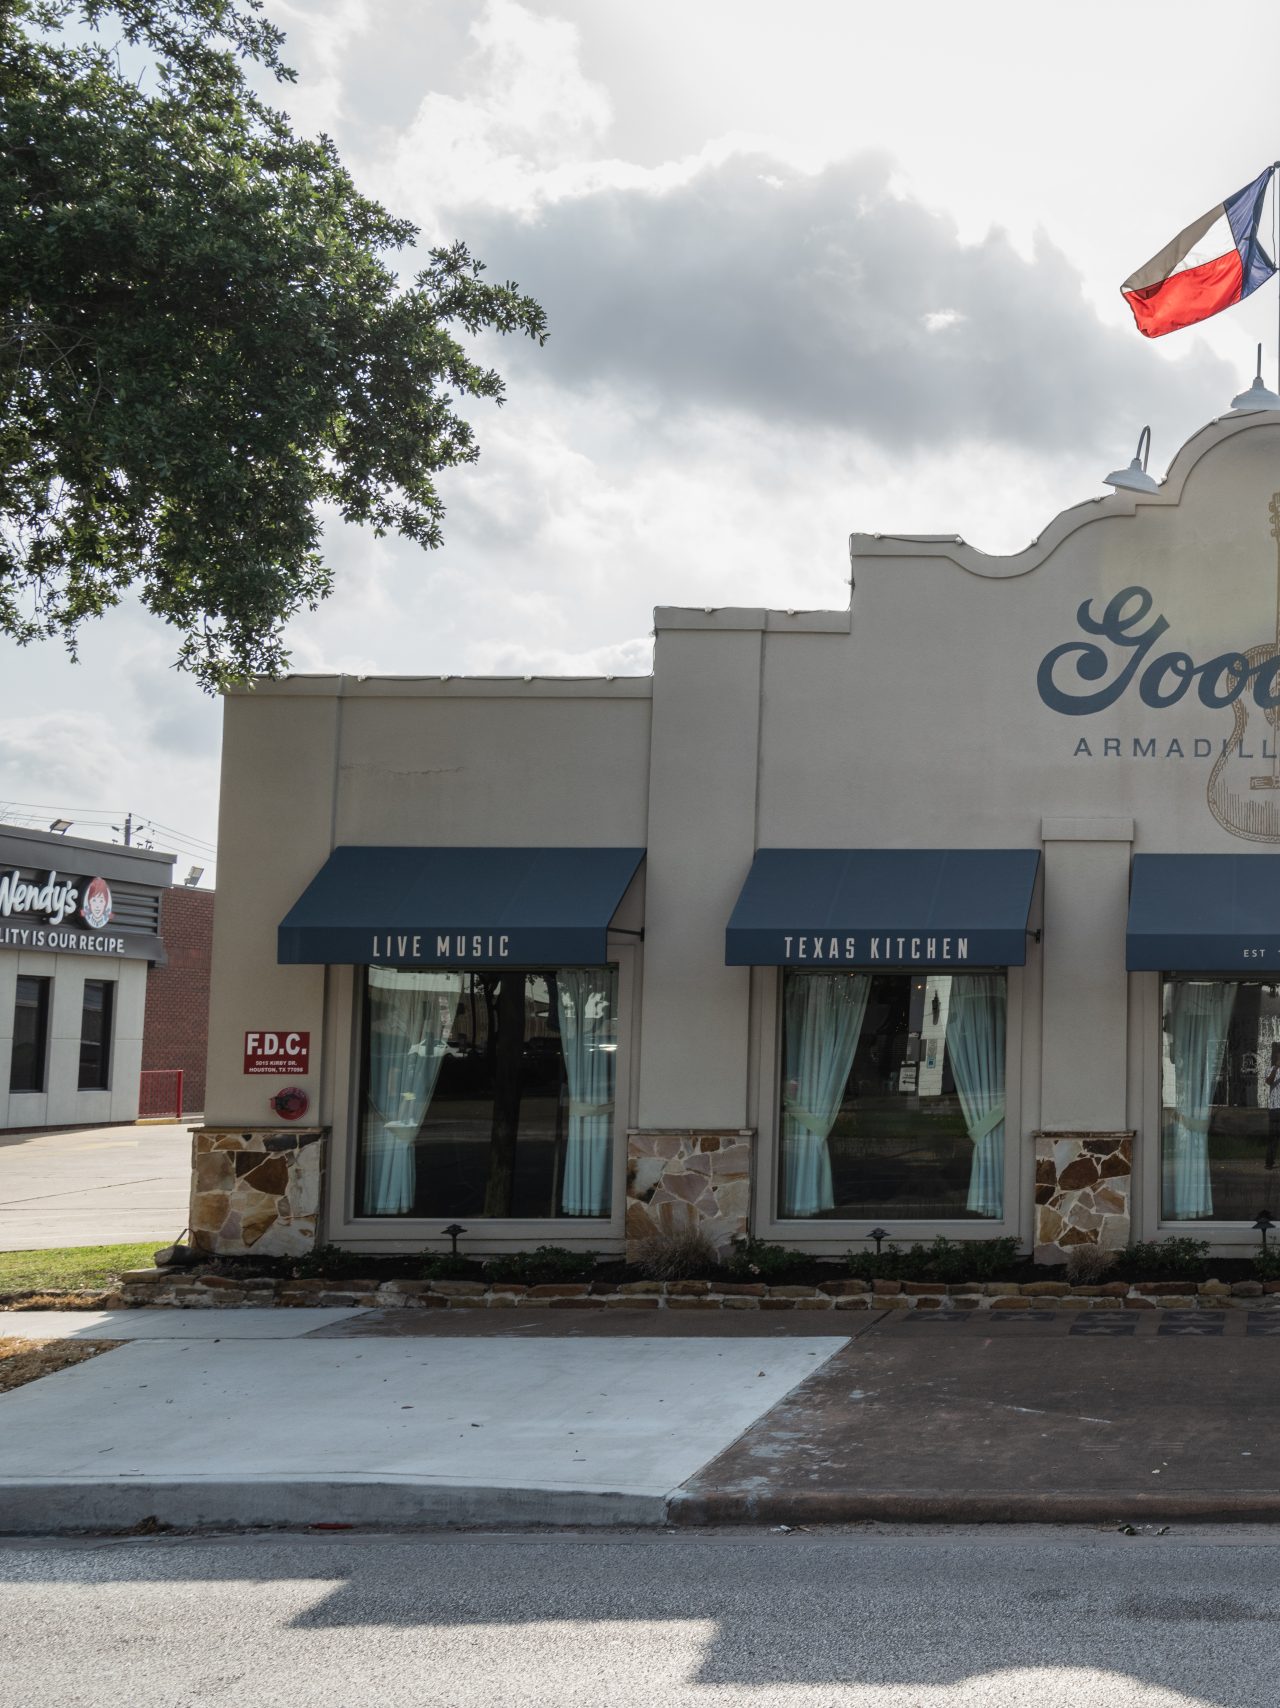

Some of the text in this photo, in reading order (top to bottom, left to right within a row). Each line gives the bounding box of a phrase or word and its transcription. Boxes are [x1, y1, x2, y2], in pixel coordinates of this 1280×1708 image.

[0, 870, 79, 925] Wendy's
[32, 930, 45, 946] IS
[48, 932, 77, 949] OUR
[79, 935, 125, 953] RECIPE
[373, 935, 509, 957] LIVE MUSIC
[784, 936, 968, 959] TEXAS KITCHEN
[1243, 949, 1266, 958] EST
[246, 1033, 307, 1055] F.D.C.
